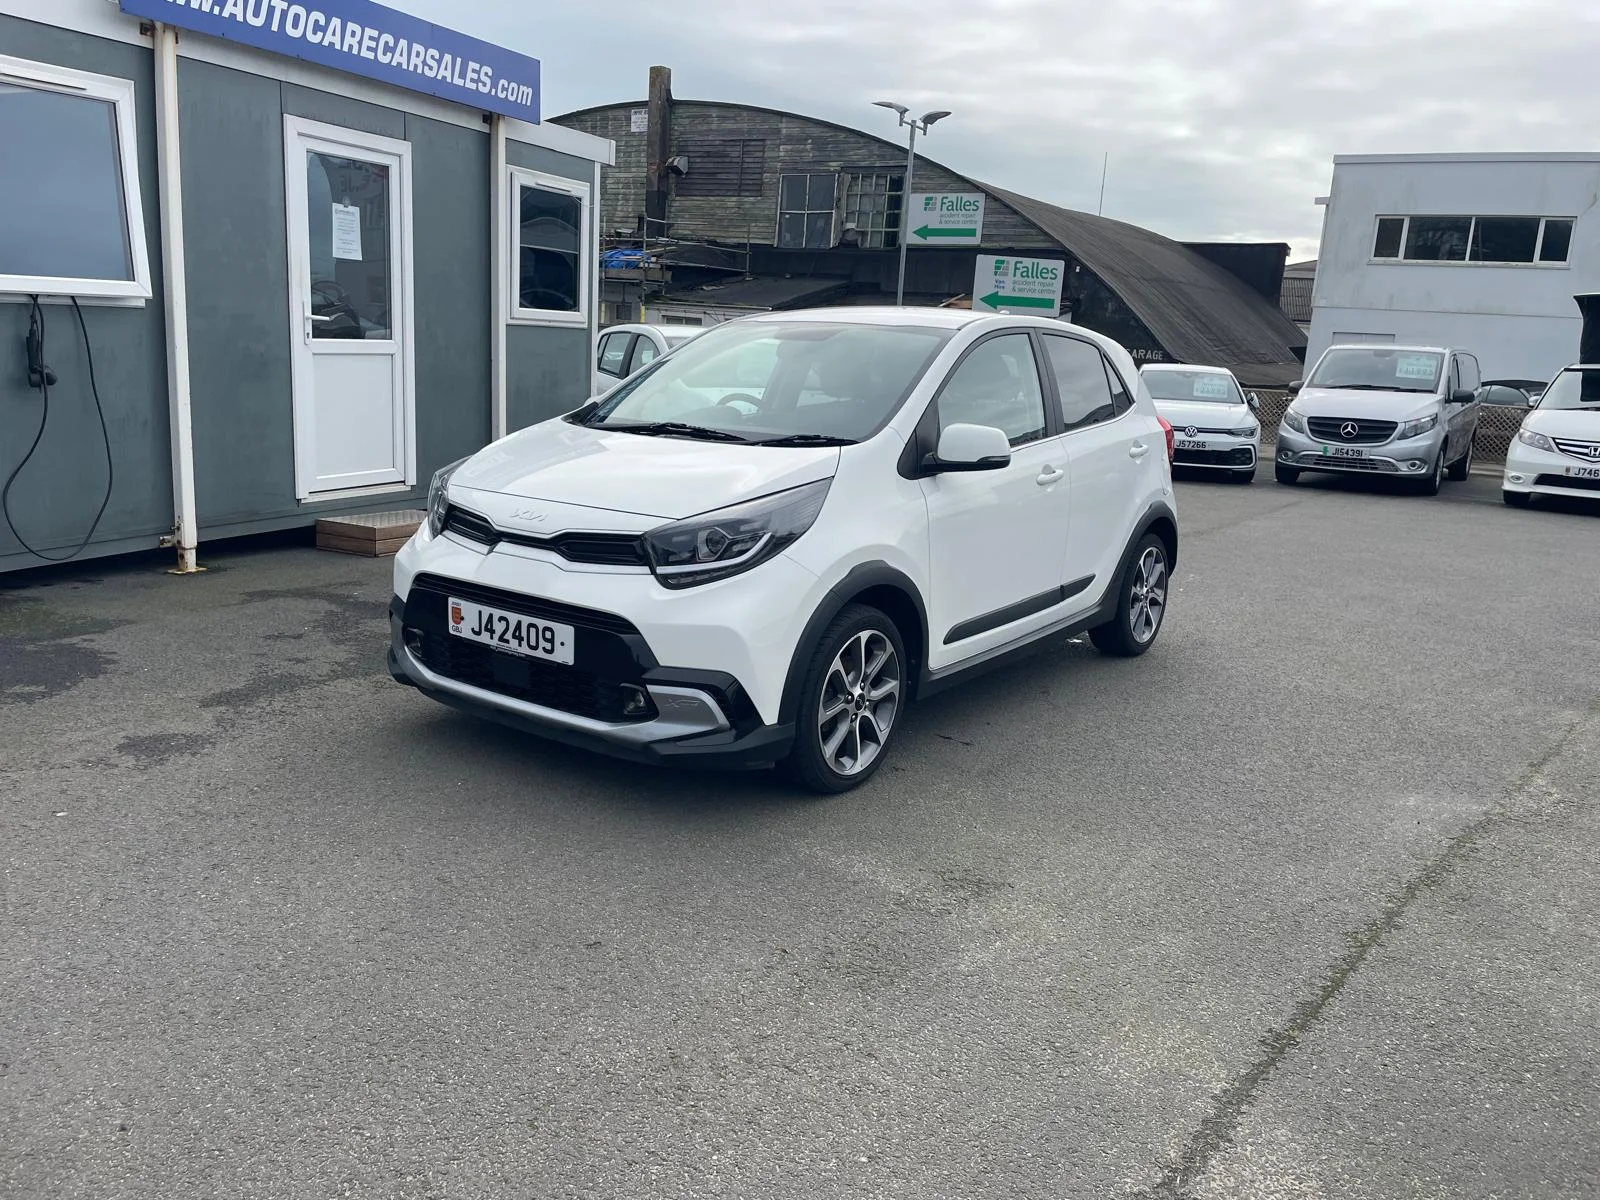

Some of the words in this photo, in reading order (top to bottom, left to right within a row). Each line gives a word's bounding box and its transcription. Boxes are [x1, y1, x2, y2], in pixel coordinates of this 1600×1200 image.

[168, 0, 532, 106] .AUTOCARECARSALES.com
[940, 196, 980, 212] Falles
[1013, 261, 1058, 280] Falles
[1127, 348, 1163, 360] ARAGE
[1176, 440, 1206, 449] J57266
[1332, 447, 1363, 457] J154391
[451, 624, 463, 634] GBJ
[470, 610, 555, 655] J42409
